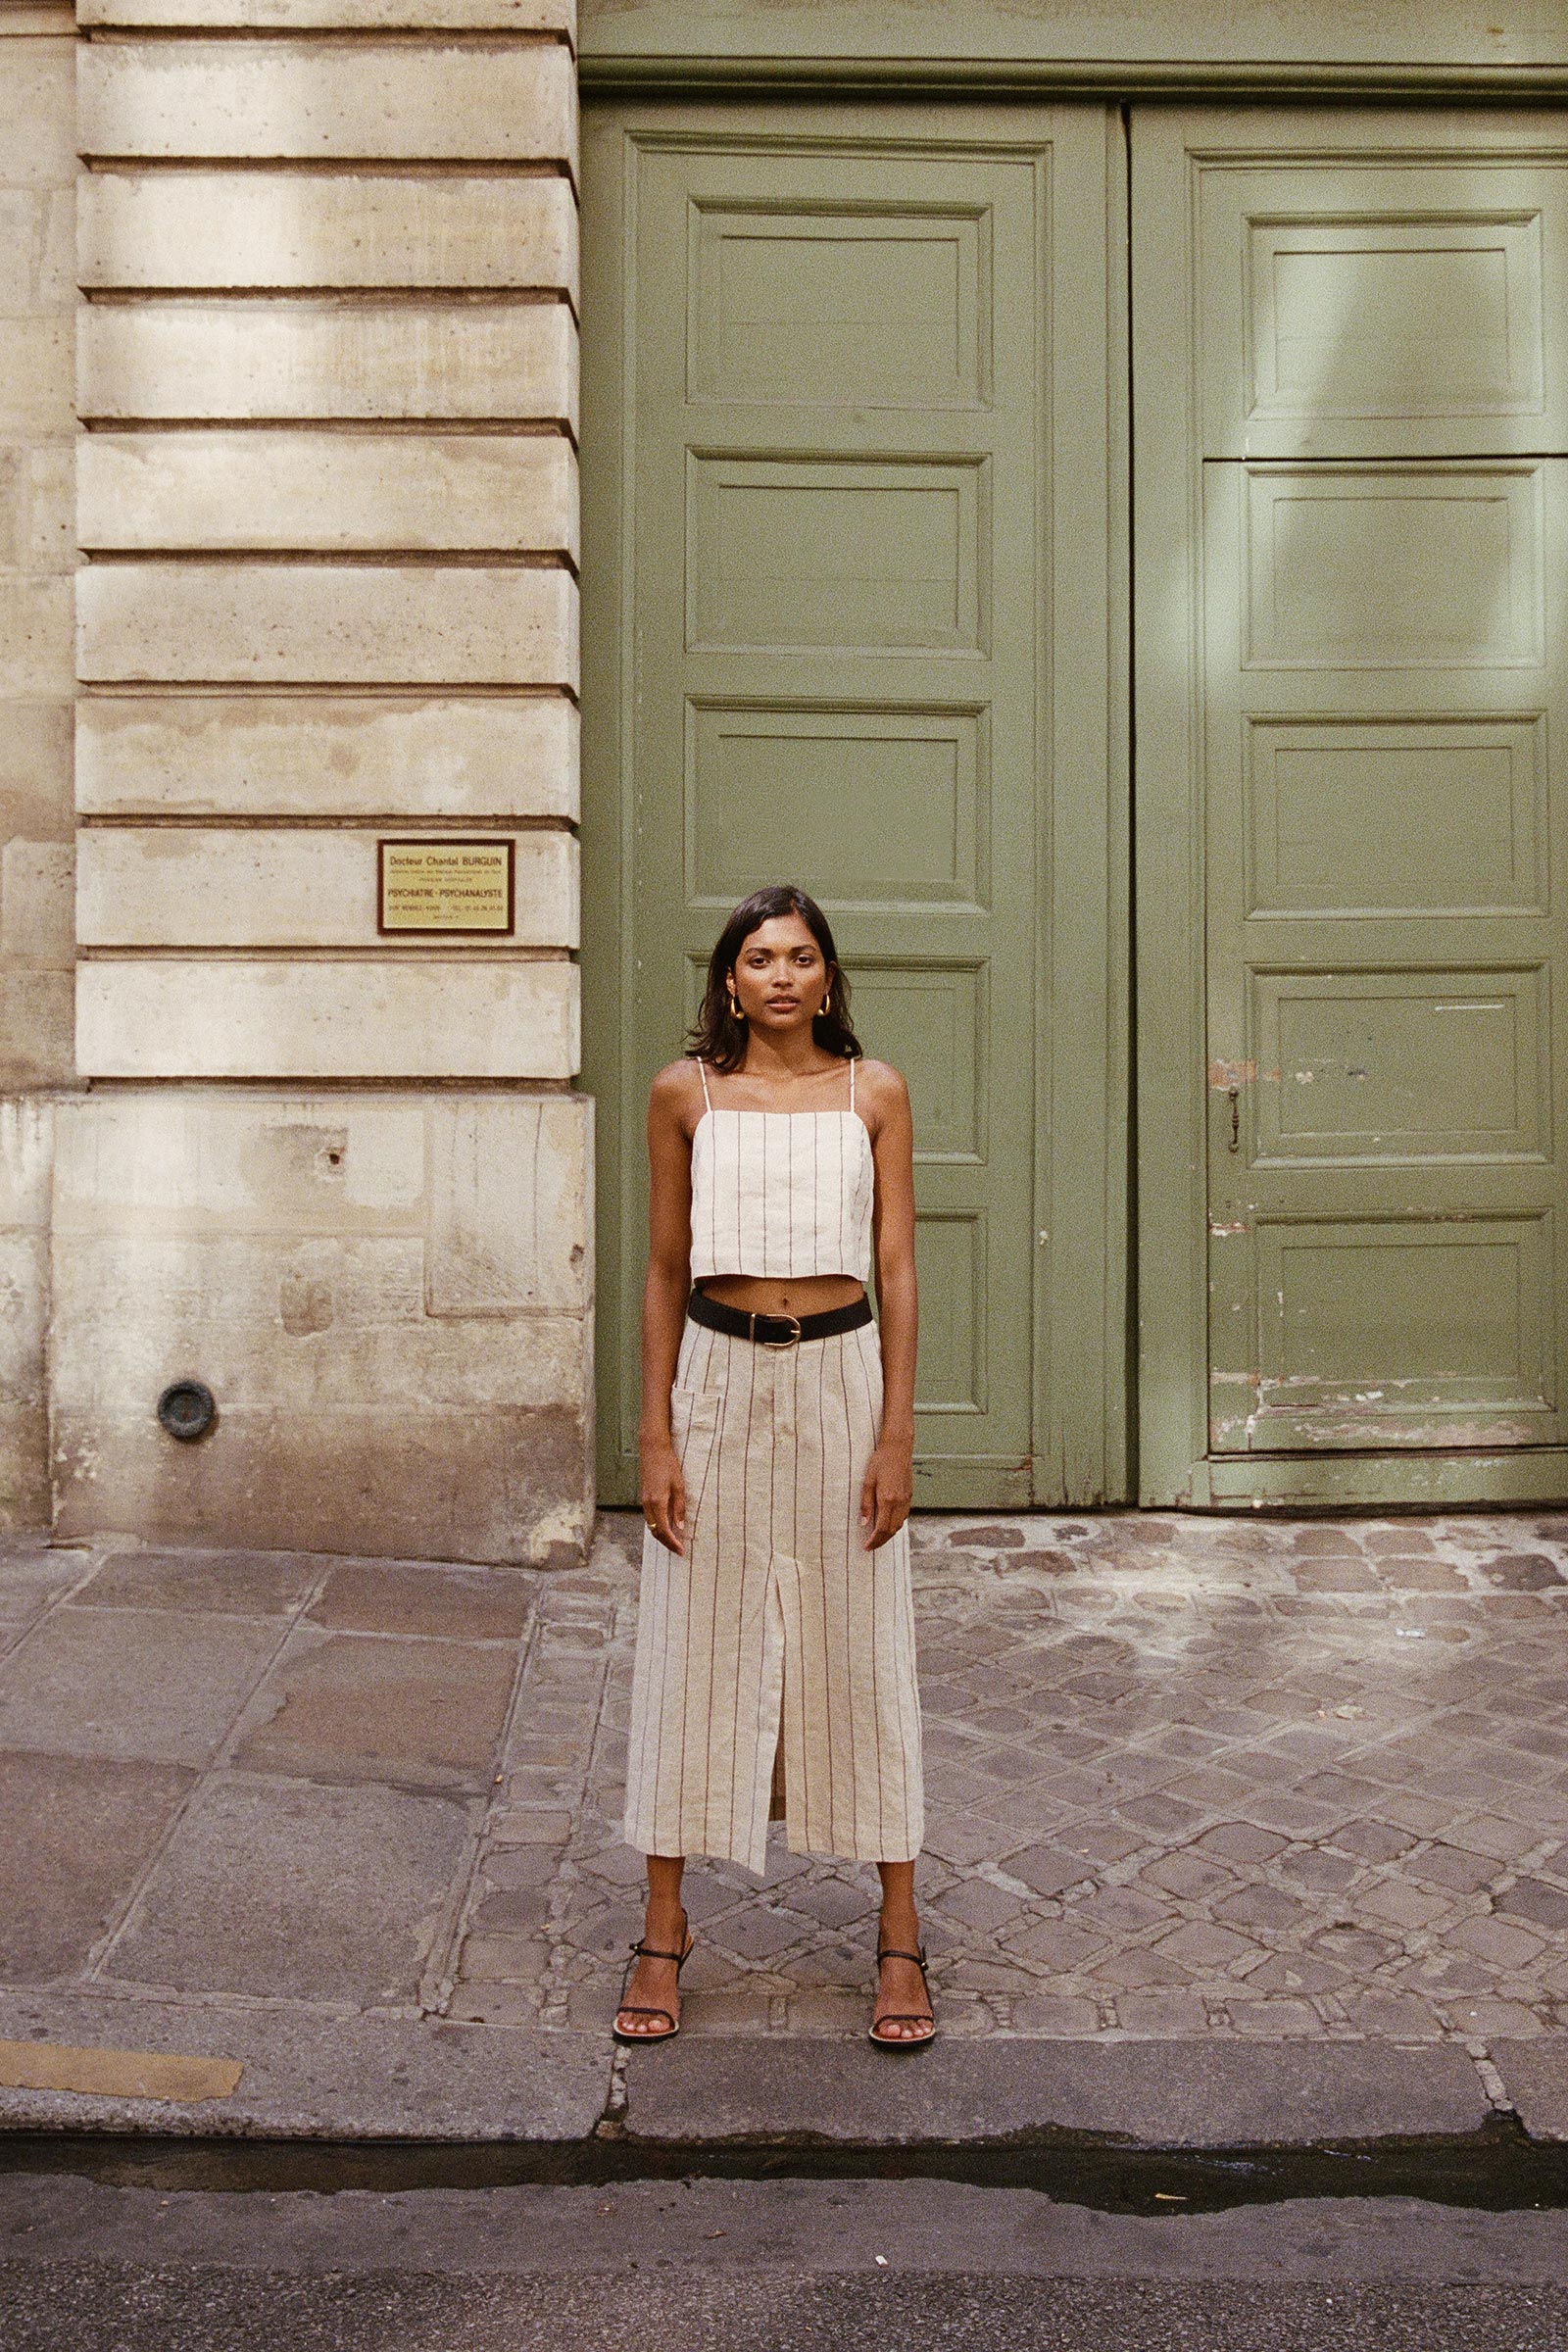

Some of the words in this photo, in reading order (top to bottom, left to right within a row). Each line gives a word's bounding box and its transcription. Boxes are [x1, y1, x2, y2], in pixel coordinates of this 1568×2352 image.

[390, 856, 422, 865] Docteur
[426, 856, 459, 865] Chantal
[462, 856, 502, 865] BURGUIN
[388, 888, 433, 898] PSYCHIATRE
[439, 888, 503, 898] PSYCHANALYSTE
